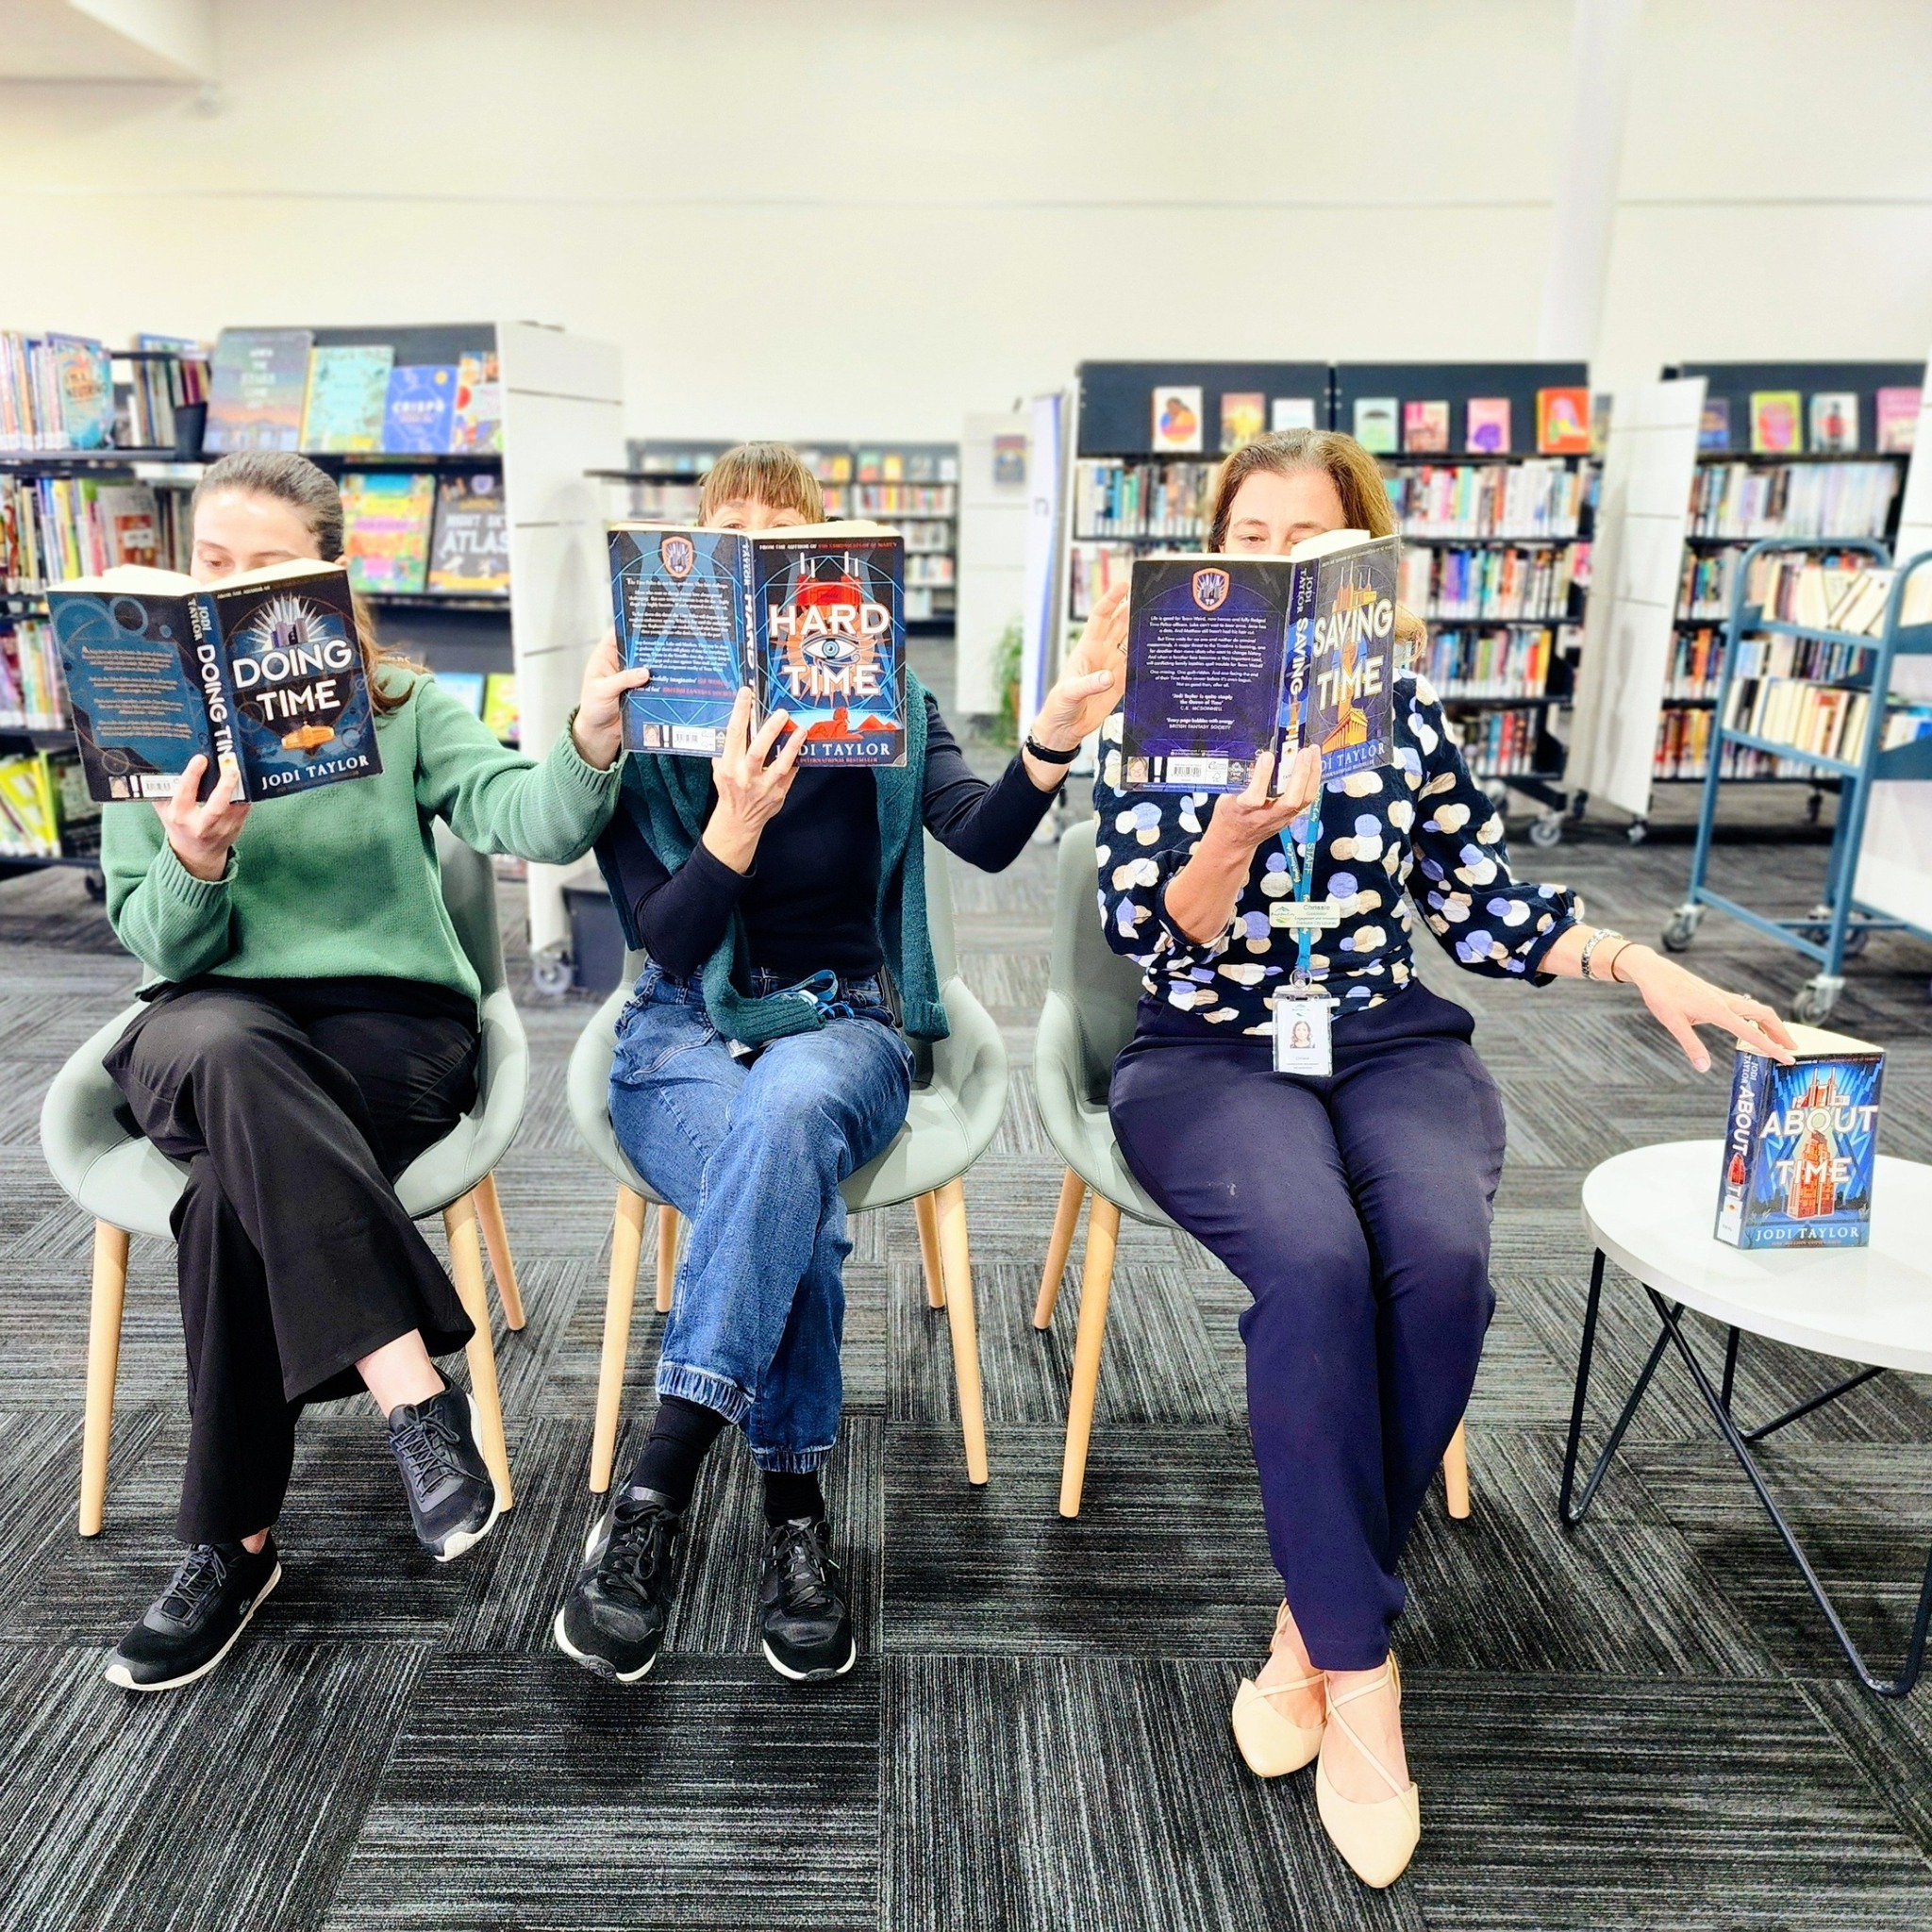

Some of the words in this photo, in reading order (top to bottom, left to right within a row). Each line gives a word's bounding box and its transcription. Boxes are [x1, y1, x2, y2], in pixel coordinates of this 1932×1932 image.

[1296, 567, 1307, 613] TAYLOR
[1305, 575, 1314, 604] JODI
[187, 597, 204, 641] TAYLOR
[198, 605, 212, 631] JODI
[743, 594, 755, 670] HARD
[769, 603, 891, 637] HARD
[1313, 598, 1393, 658] SAVING
[232, 639, 352, 689] DOING
[1290, 617, 1308, 696] SAVING
[196, 644, 228, 724] DOING
[783, 664, 881, 696] TIME
[1317, 655, 1384, 711] TIME
[256, 679, 341, 722] TIME
[1285, 720, 1299, 741] TI
[775, 743, 816, 758] JDI
[823, 743, 891, 757] TAYLOR
[1336, 741, 1386, 768] TAYLOR
[261, 769, 301, 791] JODI
[307, 755, 369, 778] TAYLOR
[1304, 841, 1315, 874] STAFF
[1740, 1053, 1753, 1084] TAYLOR
[1750, 1061, 1758, 1081] JODI
[1732, 1085, 1756, 1157] ABOUT
[1759, 1105, 1879, 1139] ABOUT
[1775, 1158, 1853, 1184] TIME
[1726, 1186, 1741, 1200] TI
[1756, 1229, 1793, 1242] JODI
[1798, 1226, 1859, 1240] TAYLOR
